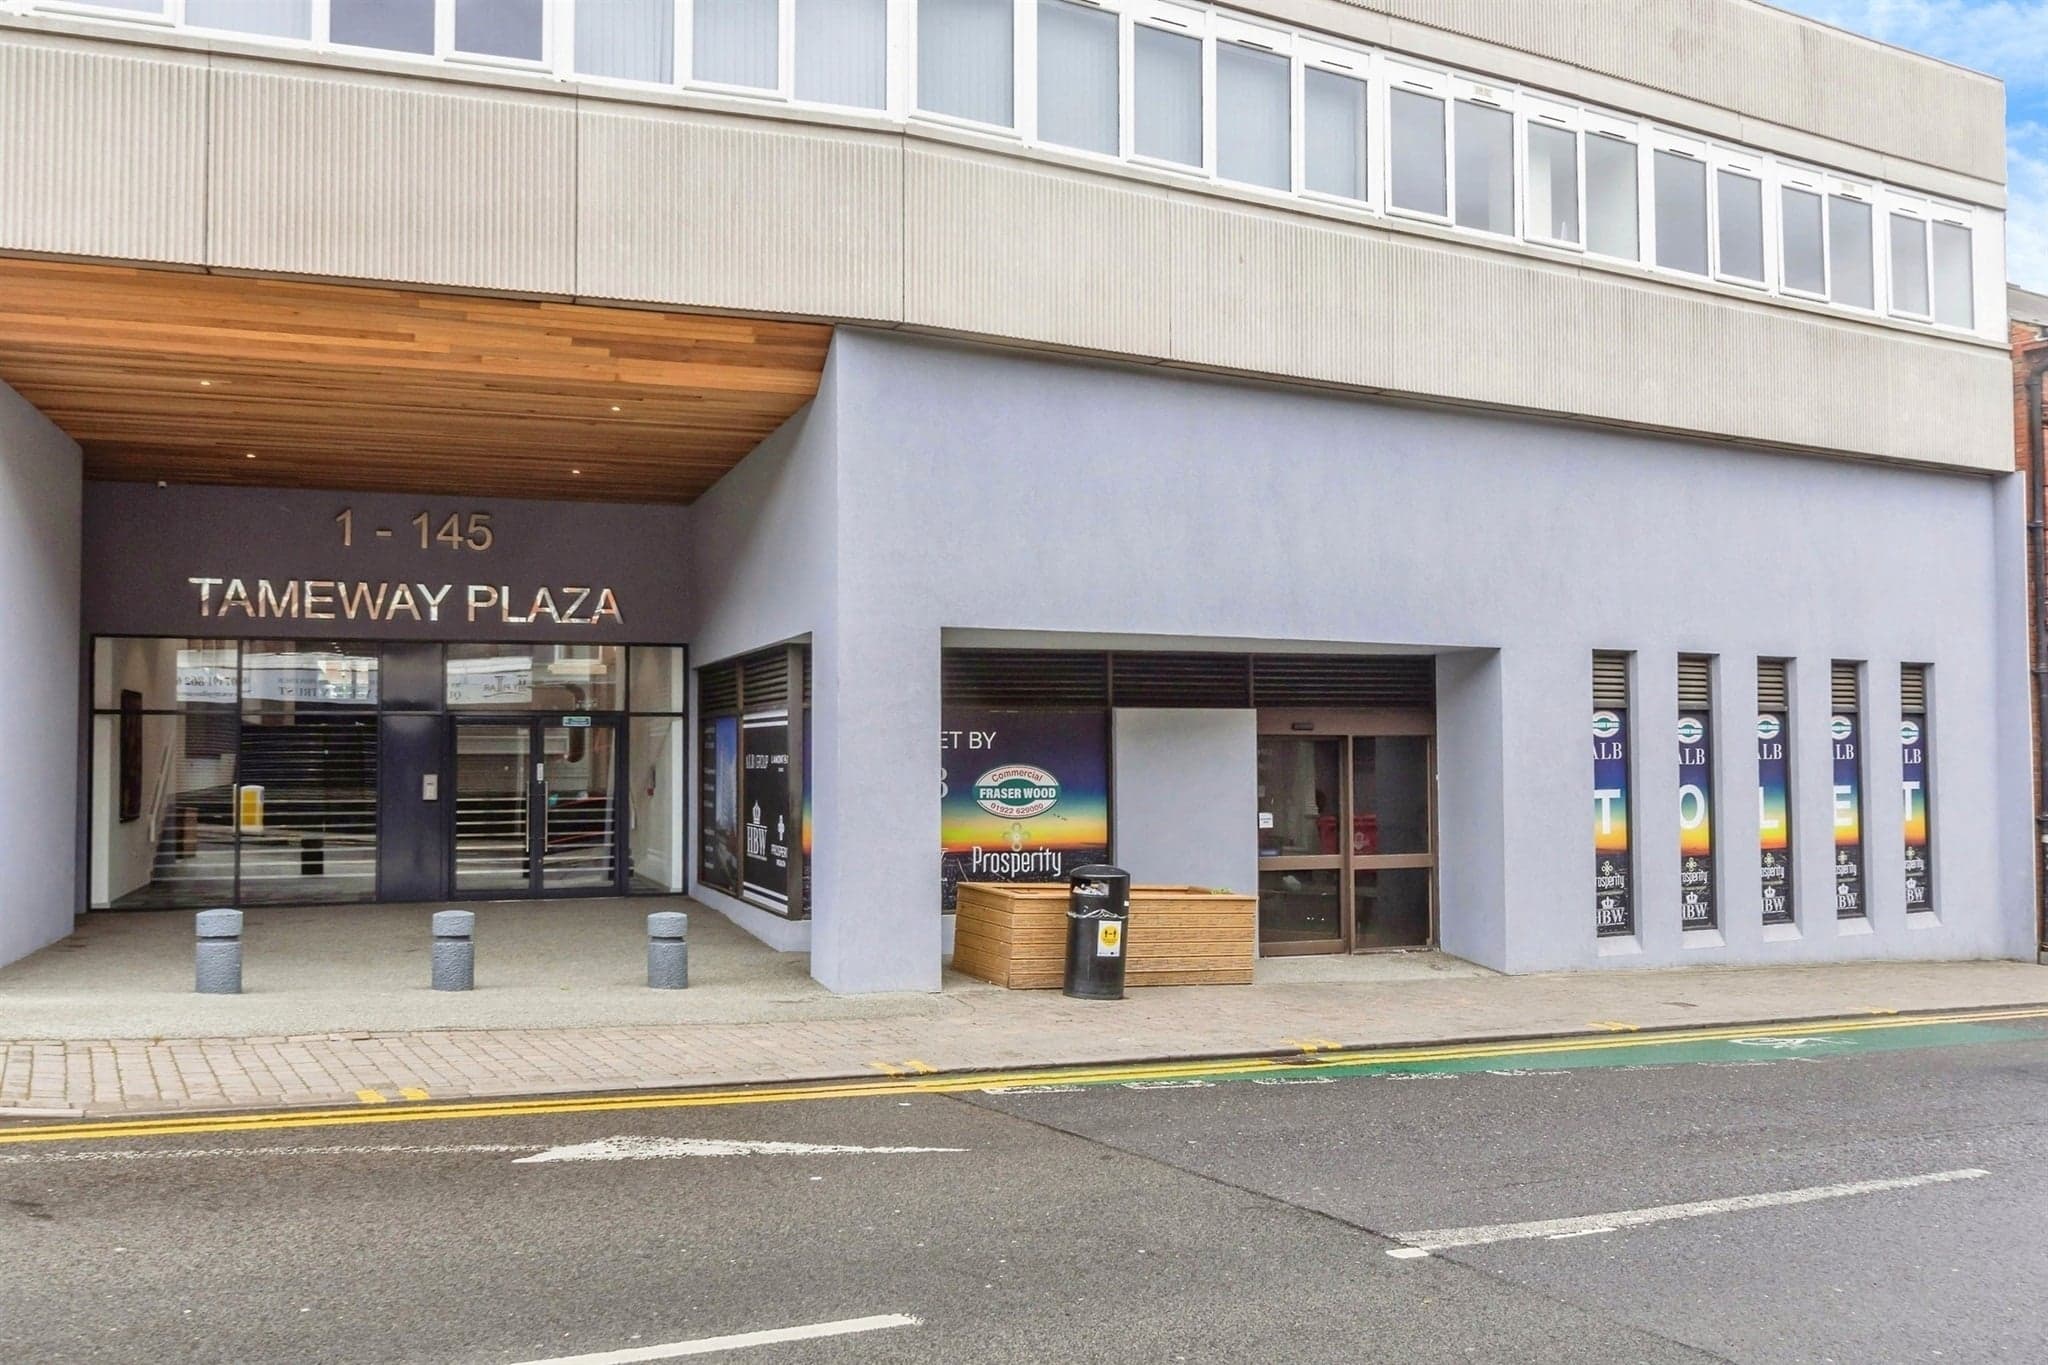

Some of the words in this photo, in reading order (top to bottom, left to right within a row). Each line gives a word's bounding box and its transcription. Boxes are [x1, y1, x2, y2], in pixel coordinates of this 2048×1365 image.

[335, 509, 351, 546] 1
[412, 511, 494, 551] 145
[188, 577, 453, 621] TAMEWAY
[467, 585, 624, 625] PLAZA
[969, 731, 997, 749] BY
[1757, 744, 1782, 760] LB
[1833, 744, 1854, 760] LB
[991, 769, 1044, 783] Commercial
[980, 787, 1021, 799] FRASER
[1023, 787, 1056, 799] WOOD
[990, 803, 1014, 814] 01922
[1594, 788, 1620, 834] T
[1679, 784, 1705, 829] O
[1758, 786, 1779, 827] L
[1833, 785, 1852, 826] E
[1902, 781, 1919, 821] T
[747, 826, 768, 857] HBW
[972, 846, 1062, 878] Prosperity
[1836, 893, 1857, 909] BW
